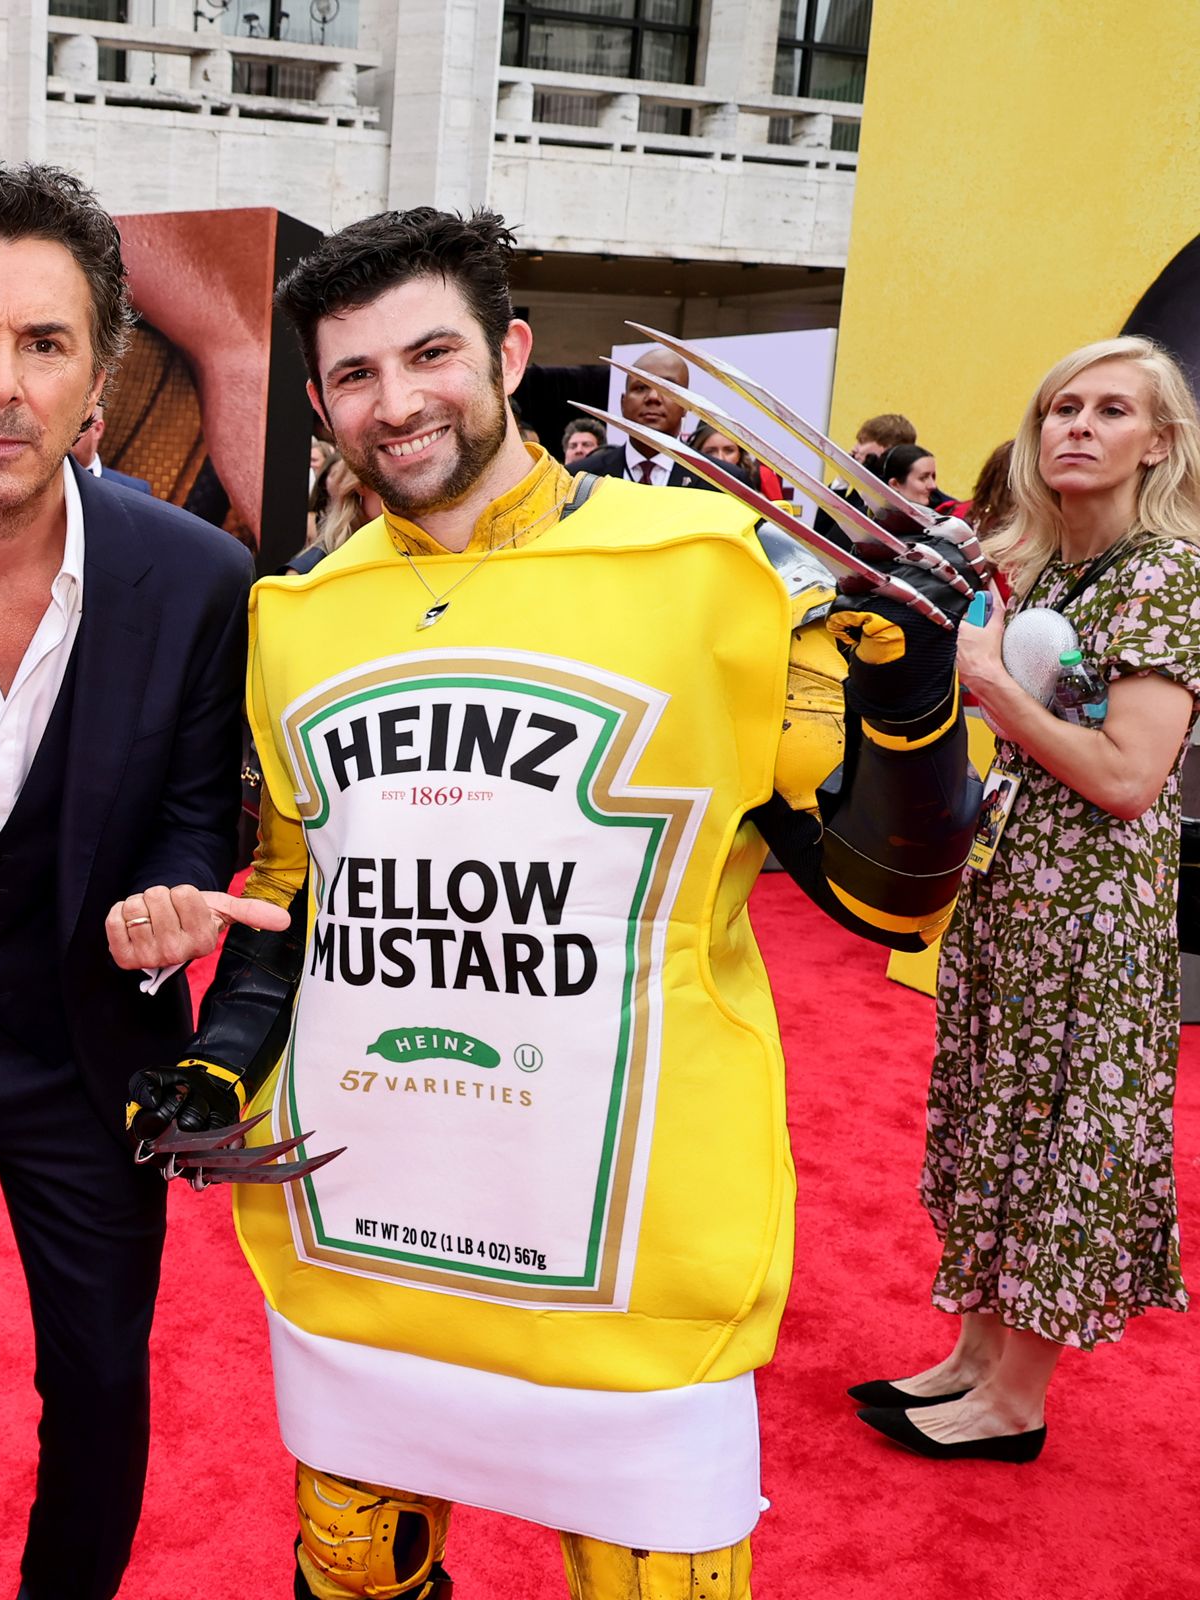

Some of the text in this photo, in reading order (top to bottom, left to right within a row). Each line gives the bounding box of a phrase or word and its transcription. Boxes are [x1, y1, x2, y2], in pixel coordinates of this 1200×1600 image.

[323, 703, 579, 793] HEINZ
[410, 786, 463, 806] 1869
[327, 856, 577, 926] YELLOW
[310, 918, 598, 997] MUSTARD
[395, 1034, 476, 1057] HEINZ
[339, 1069, 533, 1107] 57 VARIETIES
[355, 1217, 547, 1271] NET WT 20 OZ (1 LB 4 OZ) 567g
